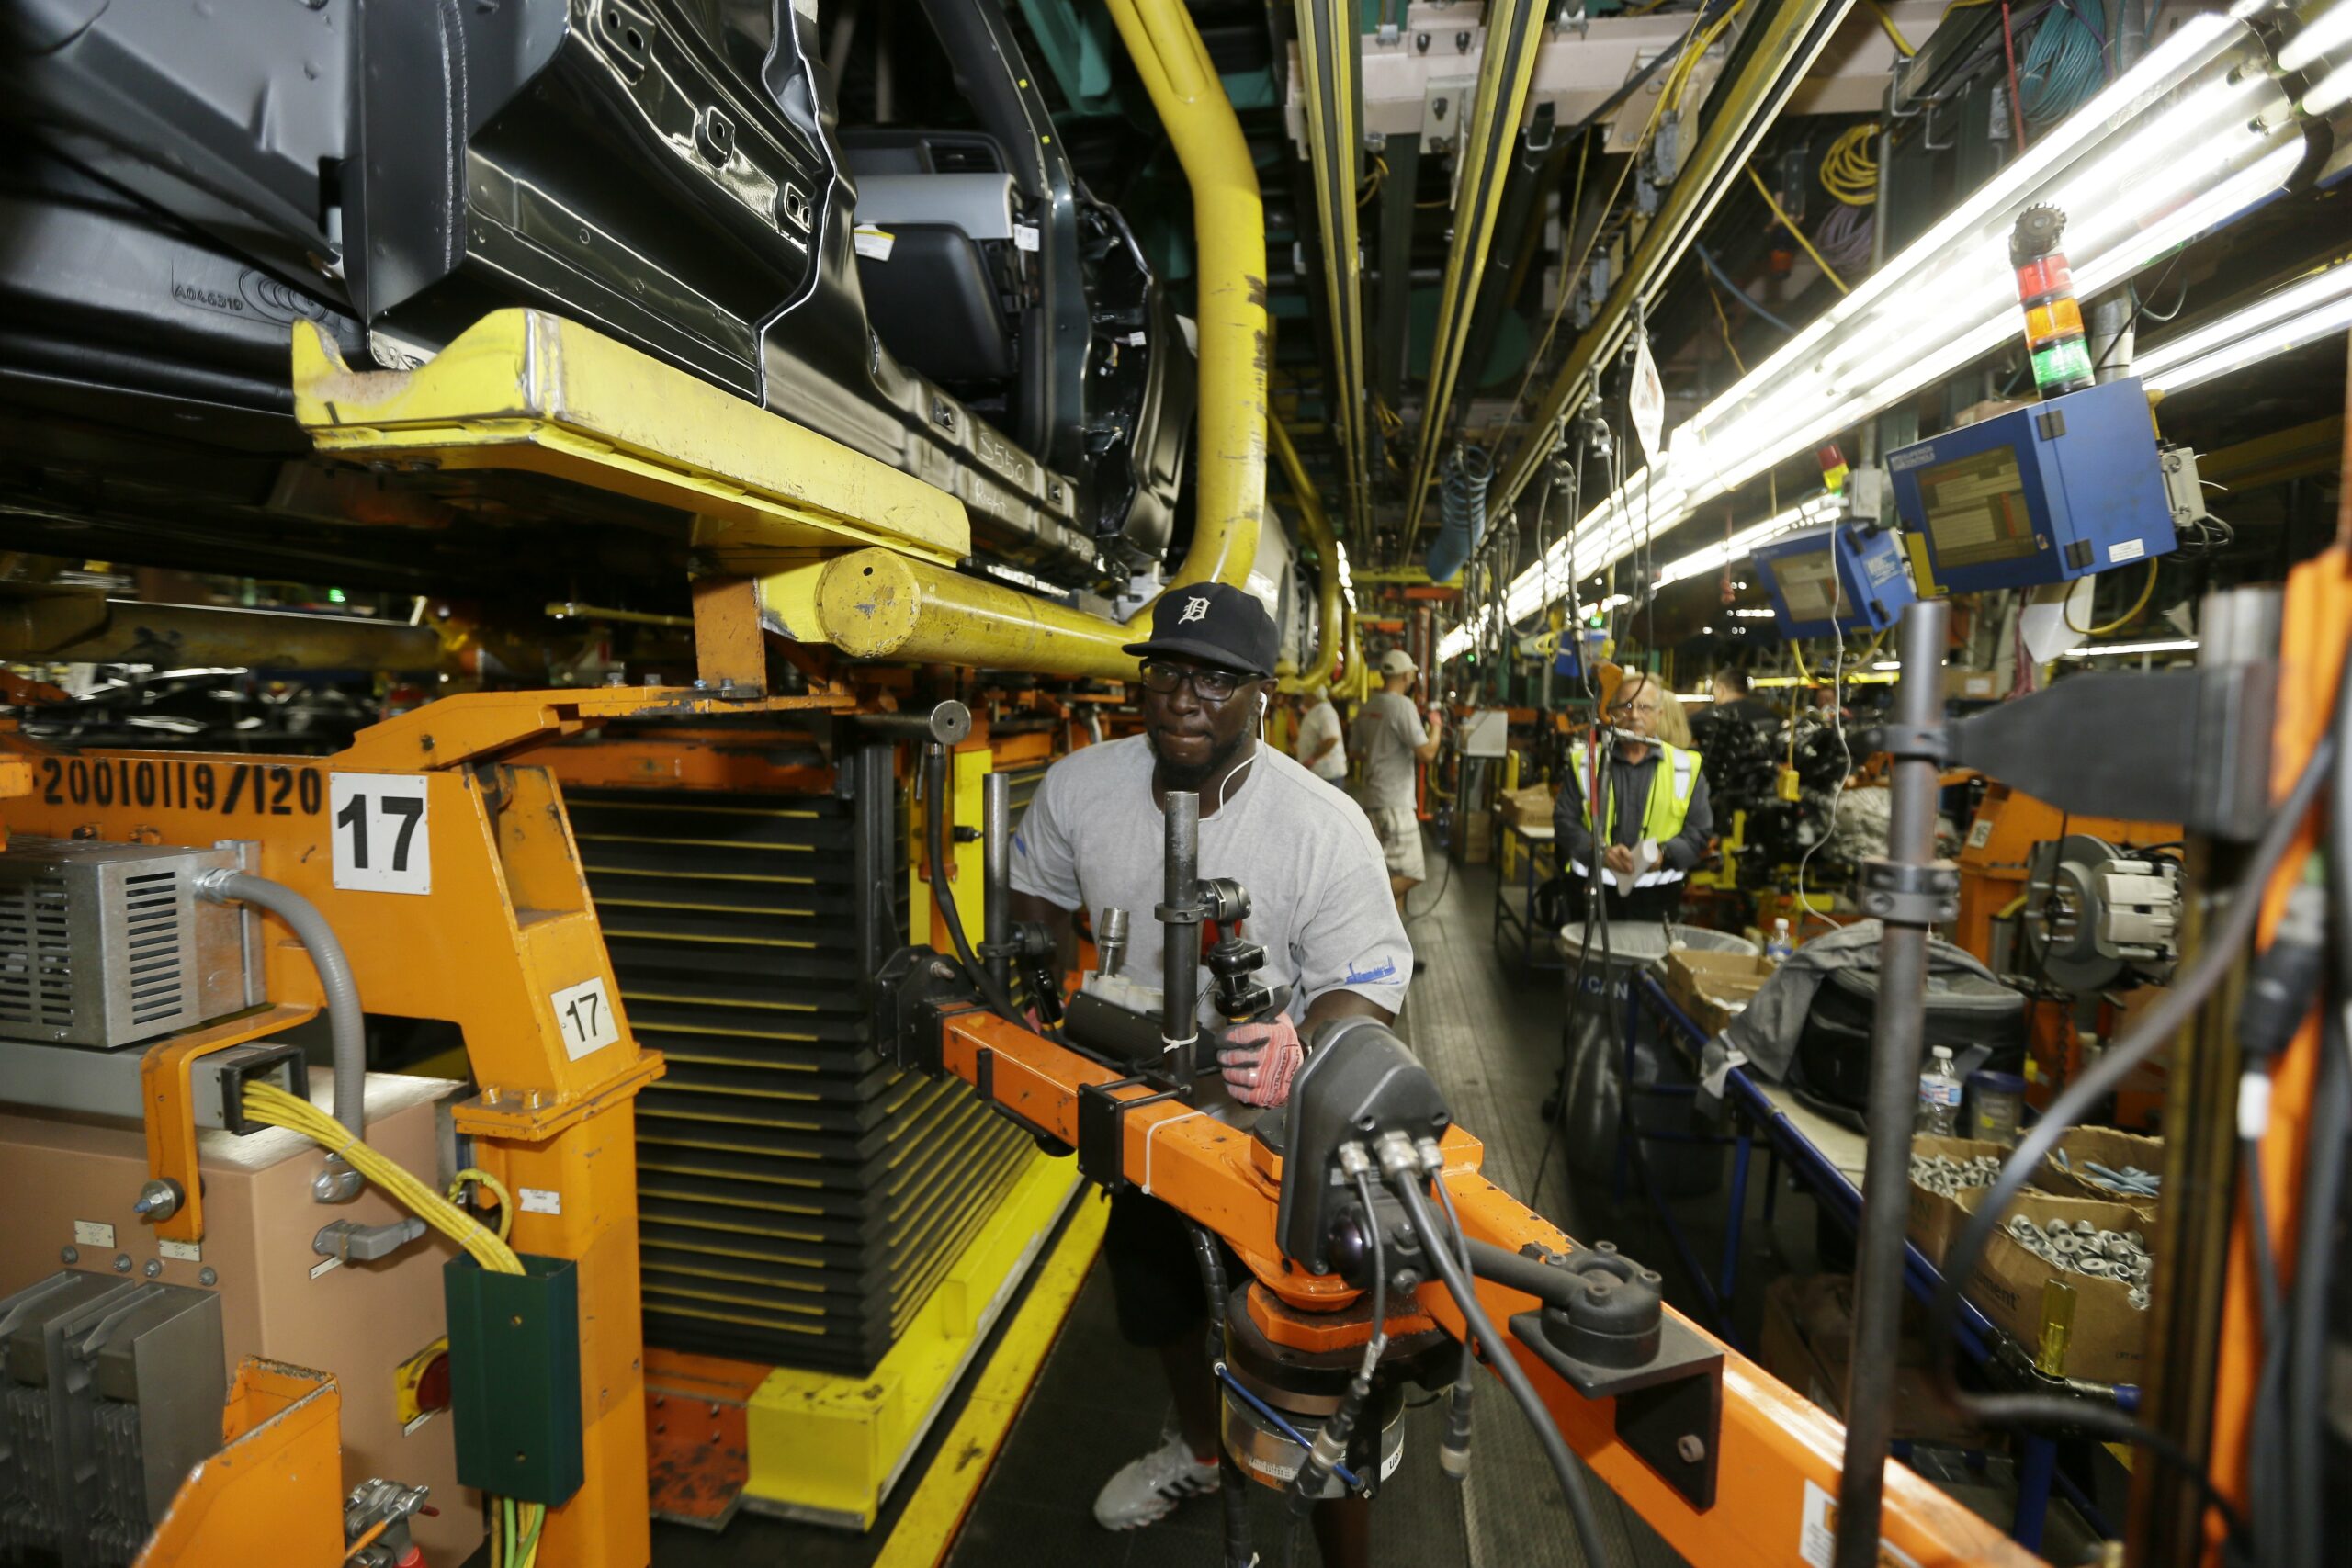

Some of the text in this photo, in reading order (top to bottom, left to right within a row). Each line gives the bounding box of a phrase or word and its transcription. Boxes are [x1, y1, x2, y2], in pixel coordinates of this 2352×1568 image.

[979, 432, 1025, 482] S550
[1178, 596, 1211, 625] D
[338, 794, 424, 872] 17
[566, 992, 598, 1042] 17
